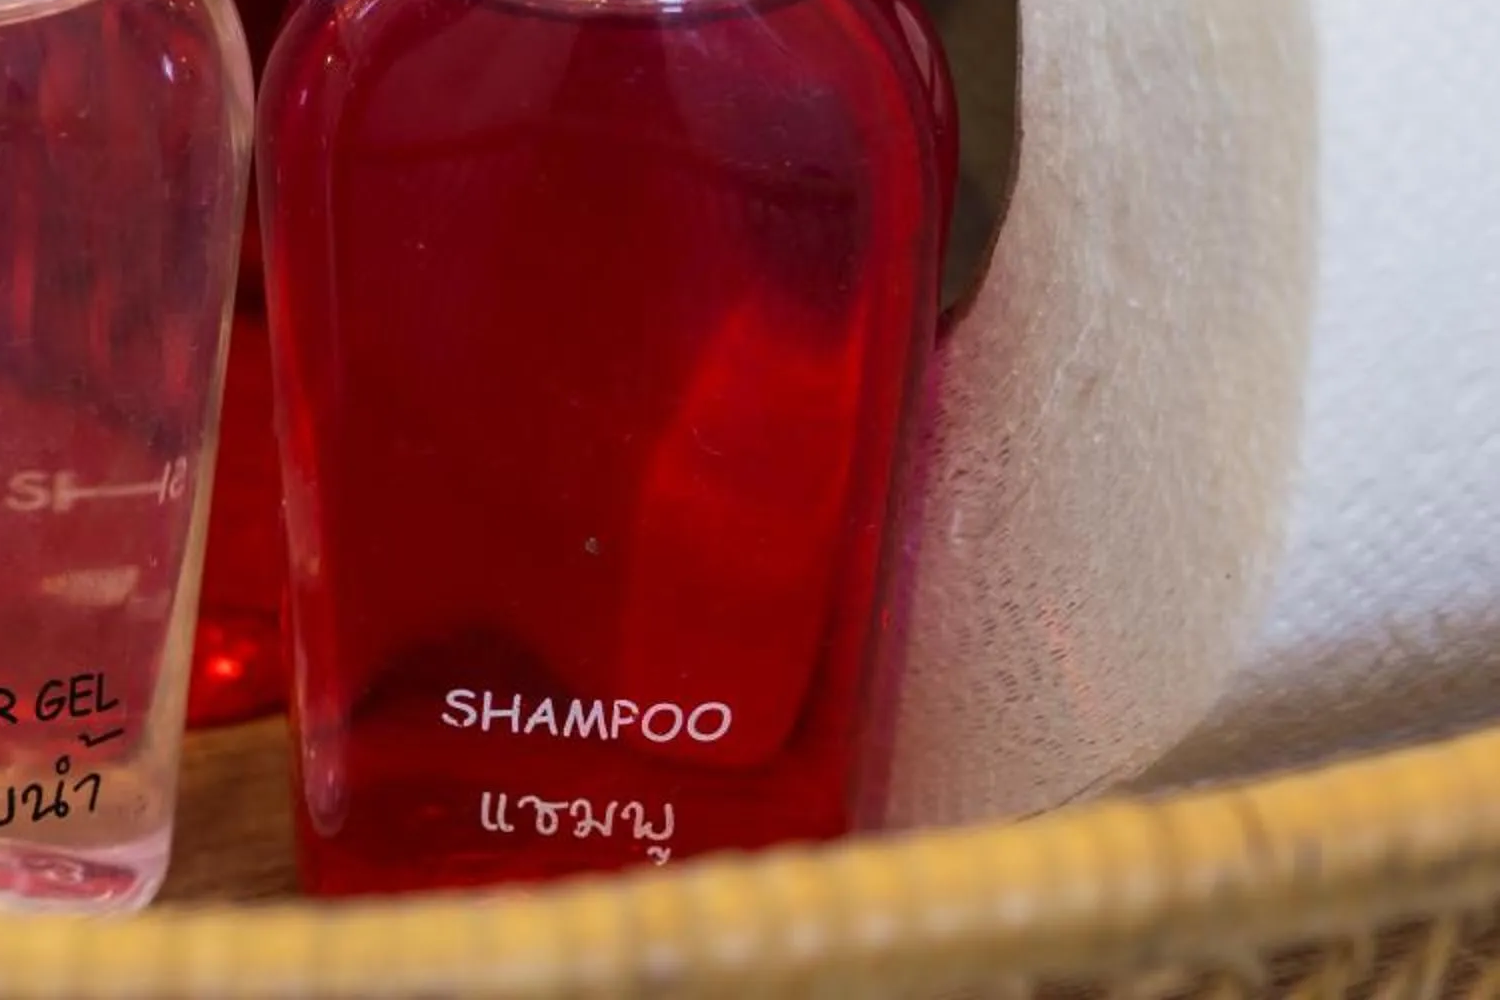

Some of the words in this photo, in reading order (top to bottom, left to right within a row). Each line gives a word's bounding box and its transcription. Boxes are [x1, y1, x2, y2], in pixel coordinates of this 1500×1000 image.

[35, 672, 119, 721] GEL
[441, 688, 732, 742] SHAMPOO
[480, 791, 675, 866] แชมพู
